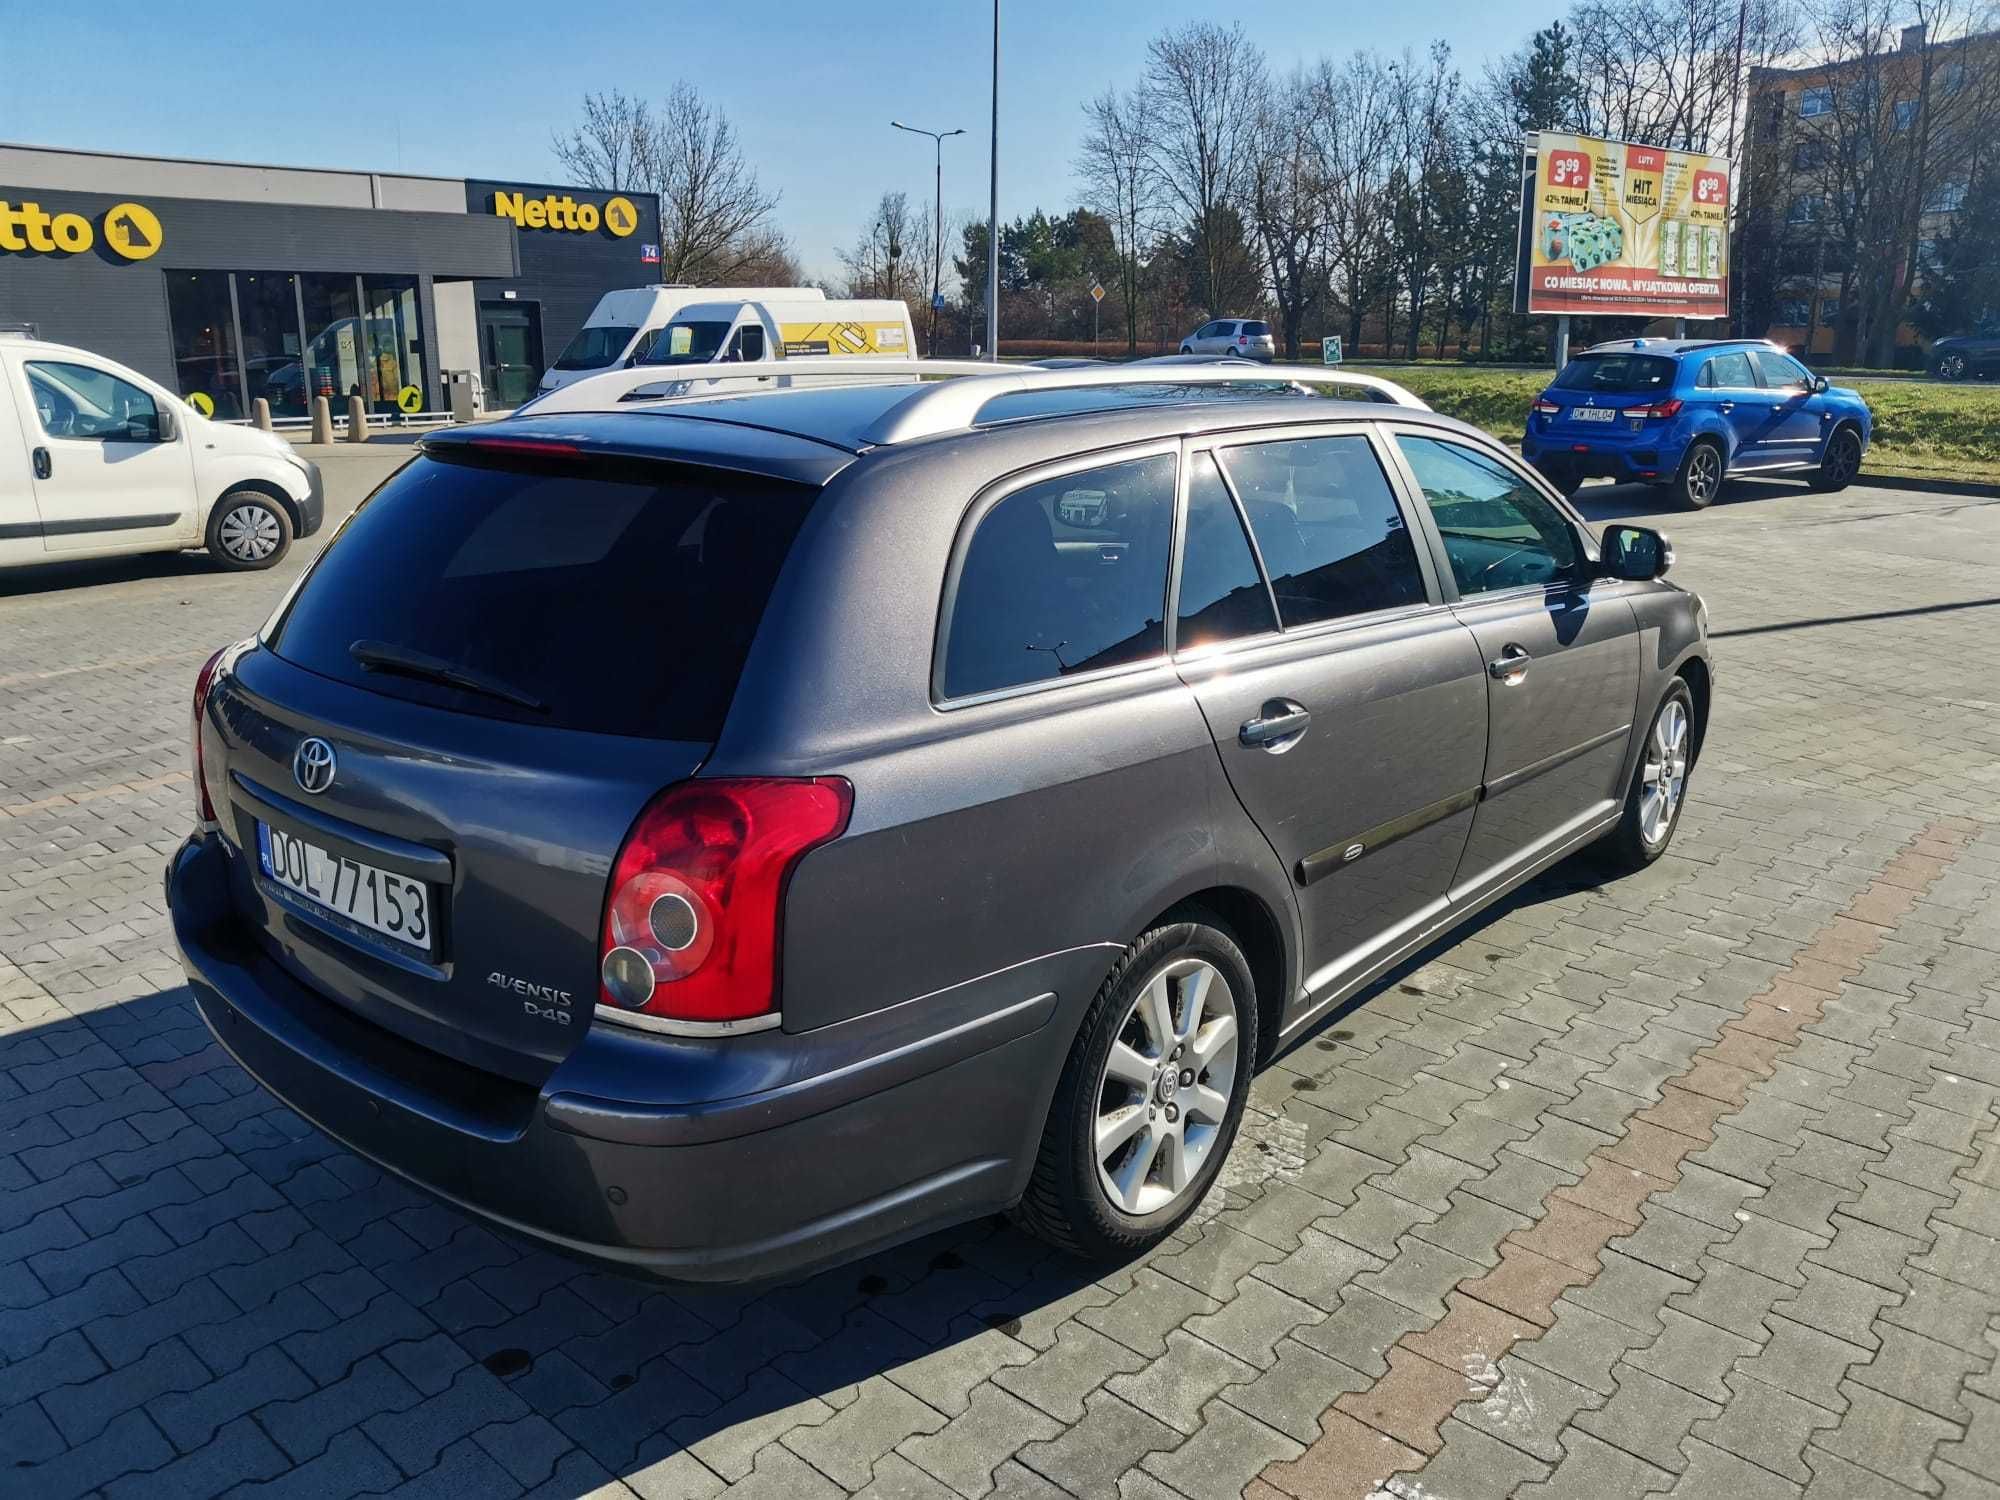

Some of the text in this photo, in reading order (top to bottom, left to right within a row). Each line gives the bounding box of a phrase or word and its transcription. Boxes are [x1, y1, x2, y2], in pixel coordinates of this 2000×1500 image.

[1638, 155, 1654, 165] LUTY
[1633, 179, 1653, 194] HIT
[1625, 194, 1657, 208] MIESIĄCA
[494, 191, 600, 232] Netto
[644, 247, 656, 258] 74
[1544, 276, 1559, 288] CO
[1559, 276, 1599, 292] MIESIĄC
[1632, 280, 1688, 295] WYJĄTKOWA
[1689, 282, 1720, 296] OFERTA
[261, 852, 272, 869] PL
[270, 829, 321, 898] DOL
[324, 855, 427, 940] 77153
[486, 971, 572, 1007] AVENSIS
[523, 1001, 571, 1026] D-4D
